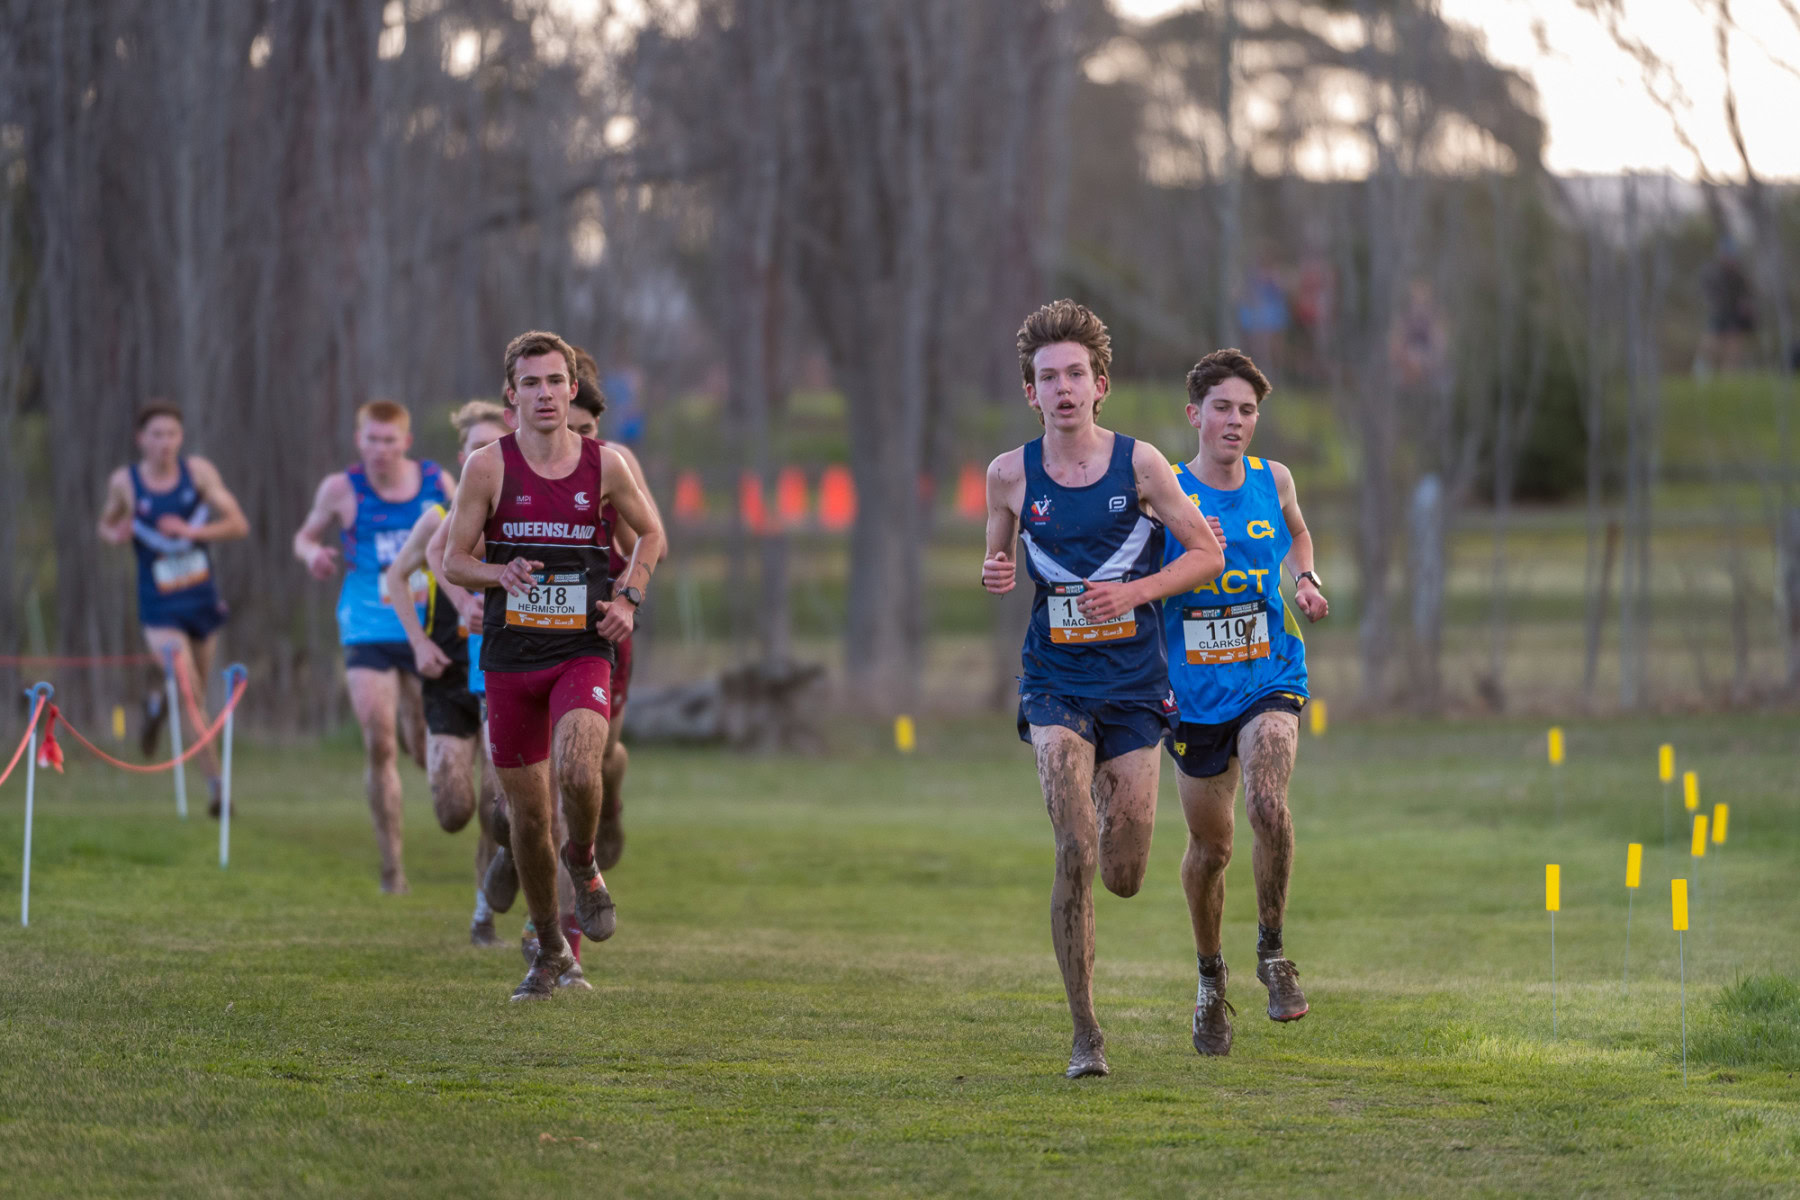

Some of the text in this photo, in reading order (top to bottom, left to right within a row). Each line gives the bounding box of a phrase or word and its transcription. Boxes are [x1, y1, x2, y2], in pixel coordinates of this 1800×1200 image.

[502, 521, 596, 540] QUEENSLAND
[1193, 569, 1269, 595] ACT
[528, 586, 567, 606] 618
[518, 603, 575, 613] HERMISTON
[1206, 618, 1247, 641] 110
